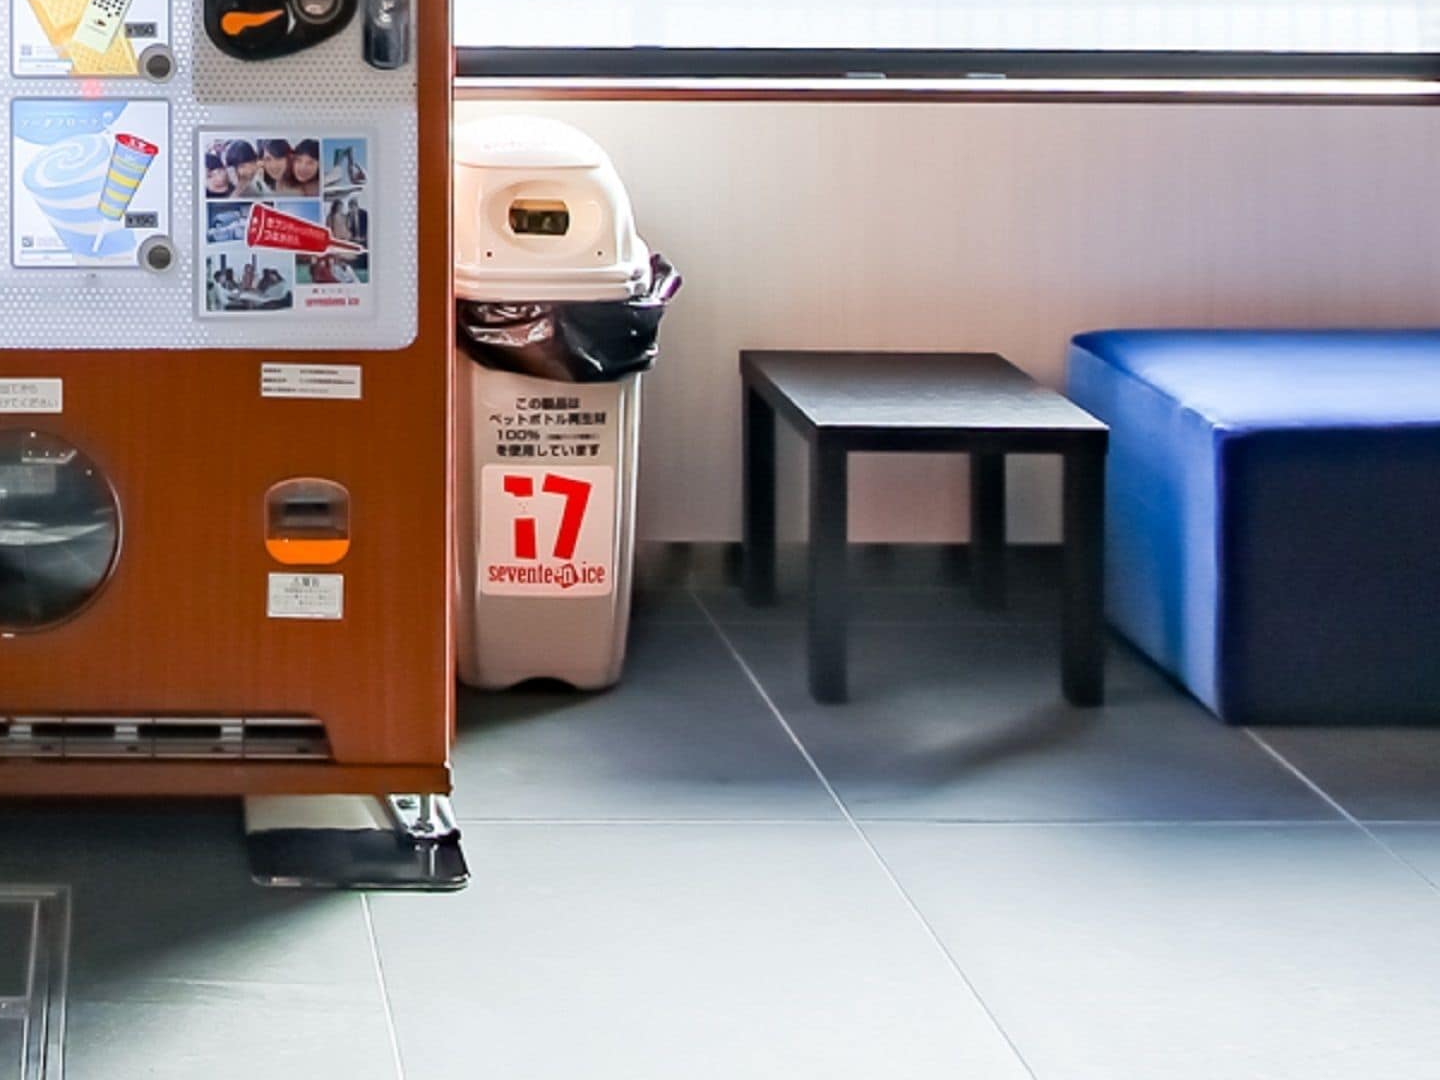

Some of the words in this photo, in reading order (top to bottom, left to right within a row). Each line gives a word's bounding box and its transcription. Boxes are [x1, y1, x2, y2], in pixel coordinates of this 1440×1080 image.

[515, 397, 580, 411] この製品は
[497, 429, 541, 441] 100%
[496, 443, 601, 457] を使用しています
[581, 560, 606, 584] ice
